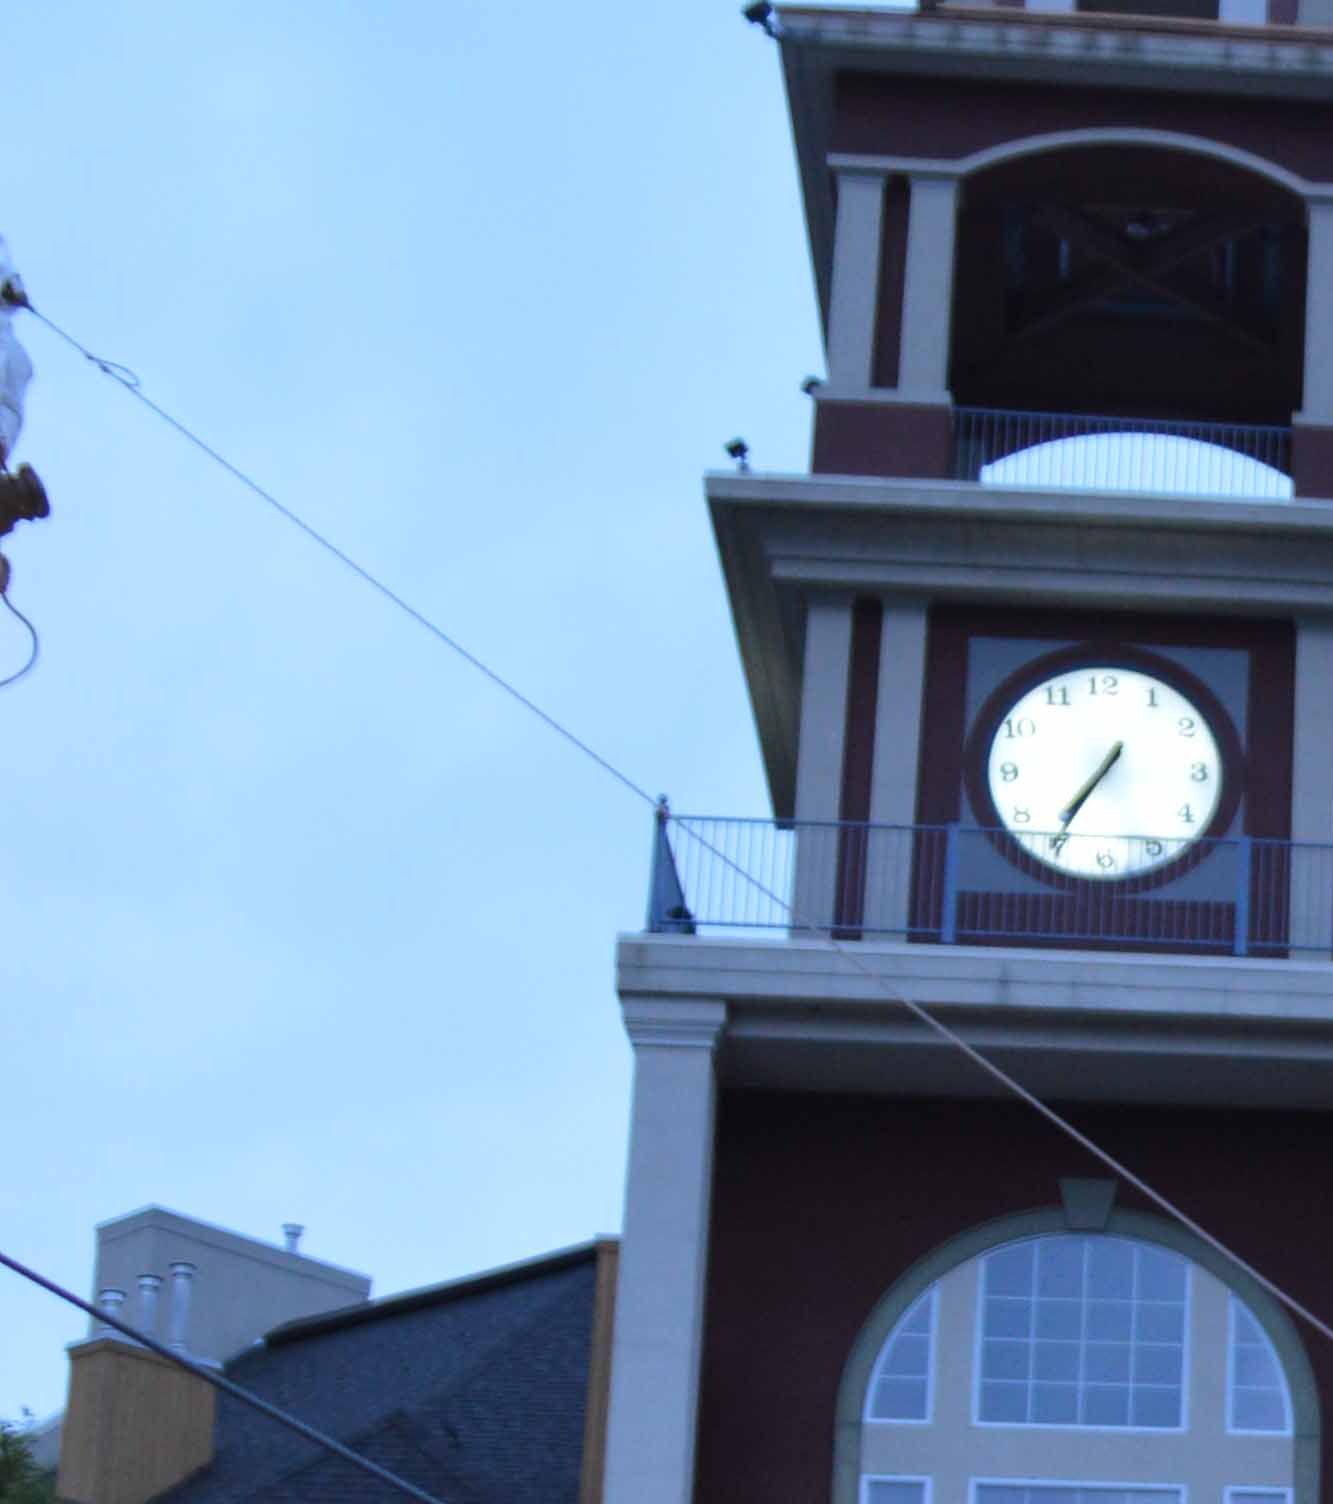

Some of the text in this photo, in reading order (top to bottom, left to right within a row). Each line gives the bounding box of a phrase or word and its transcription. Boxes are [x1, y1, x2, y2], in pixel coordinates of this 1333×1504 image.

[1088, 675, 1118, 696] 12
[1045, 686, 1071, 706] 11
[1145, 687, 1159, 707] 1
[1004, 718, 1035, 738] 10
[1178, 717, 1195, 737] 2
[1000, 762, 1019, 782] 9
[1191, 762, 1209, 782] 3
[1013, 804, 1031, 824] 8
[1178, 803, 1195, 823] 4
[1049, 833, 1070, 858] 7
[1146, 838, 1163, 857] 5
[1096, 849, 1113, 869] 6
